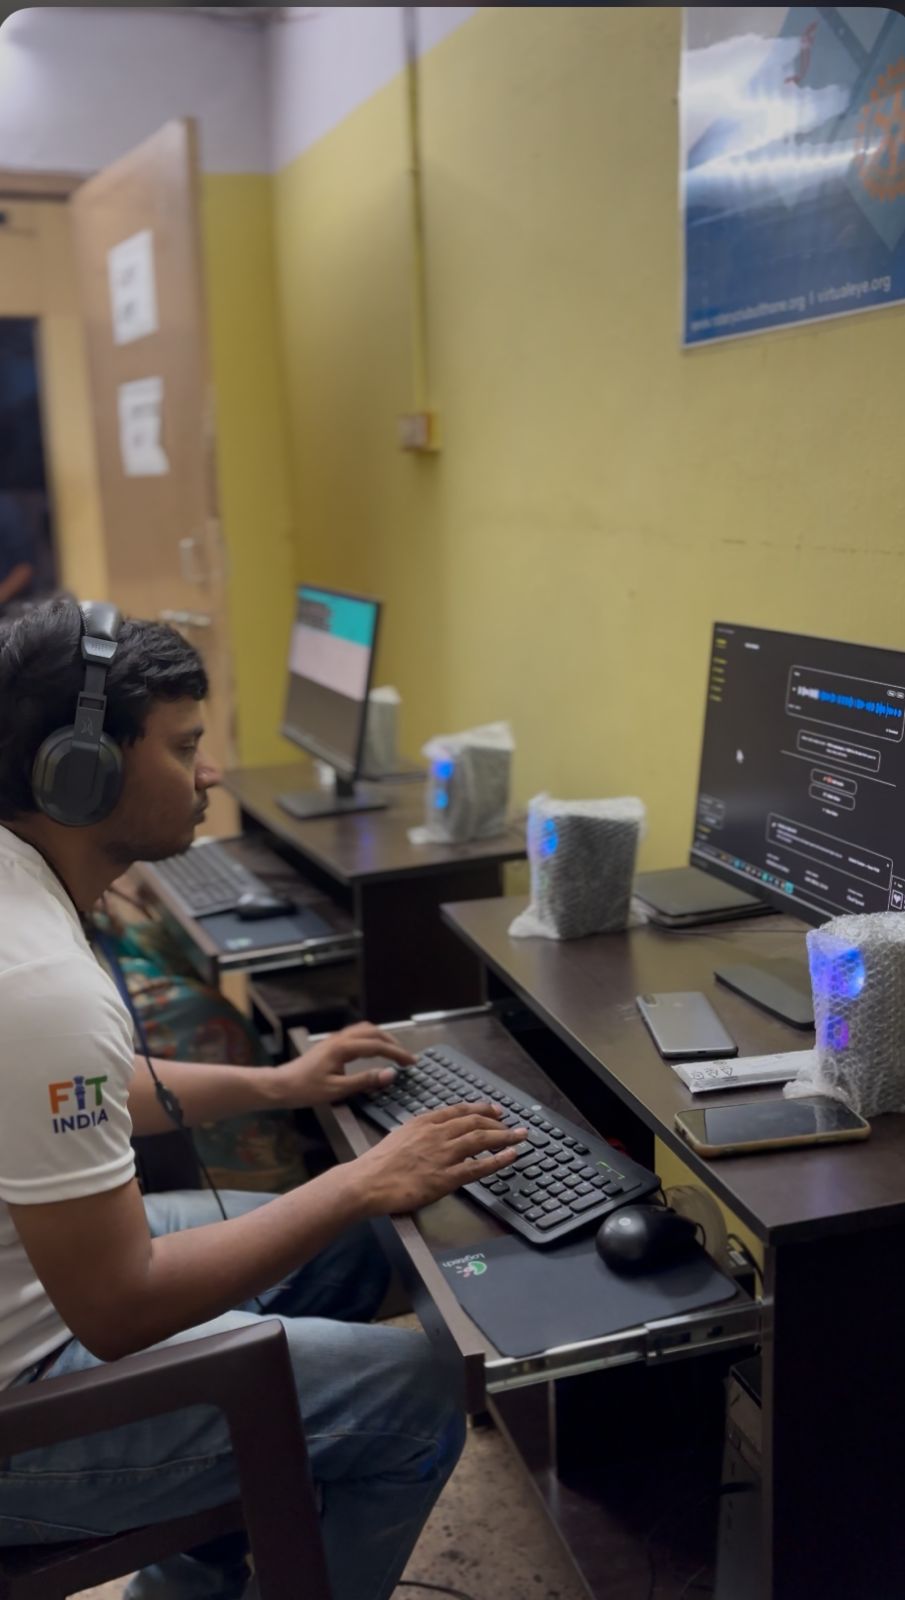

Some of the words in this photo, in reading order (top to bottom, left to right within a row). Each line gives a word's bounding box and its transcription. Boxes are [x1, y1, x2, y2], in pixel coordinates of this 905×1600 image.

[817, 275, 892, 304] virtualeye.org
[48, 1074, 108, 1115] FIT
[52, 1109, 109, 1134] INDIA
[442, 1252, 486, 1267] Logitech
